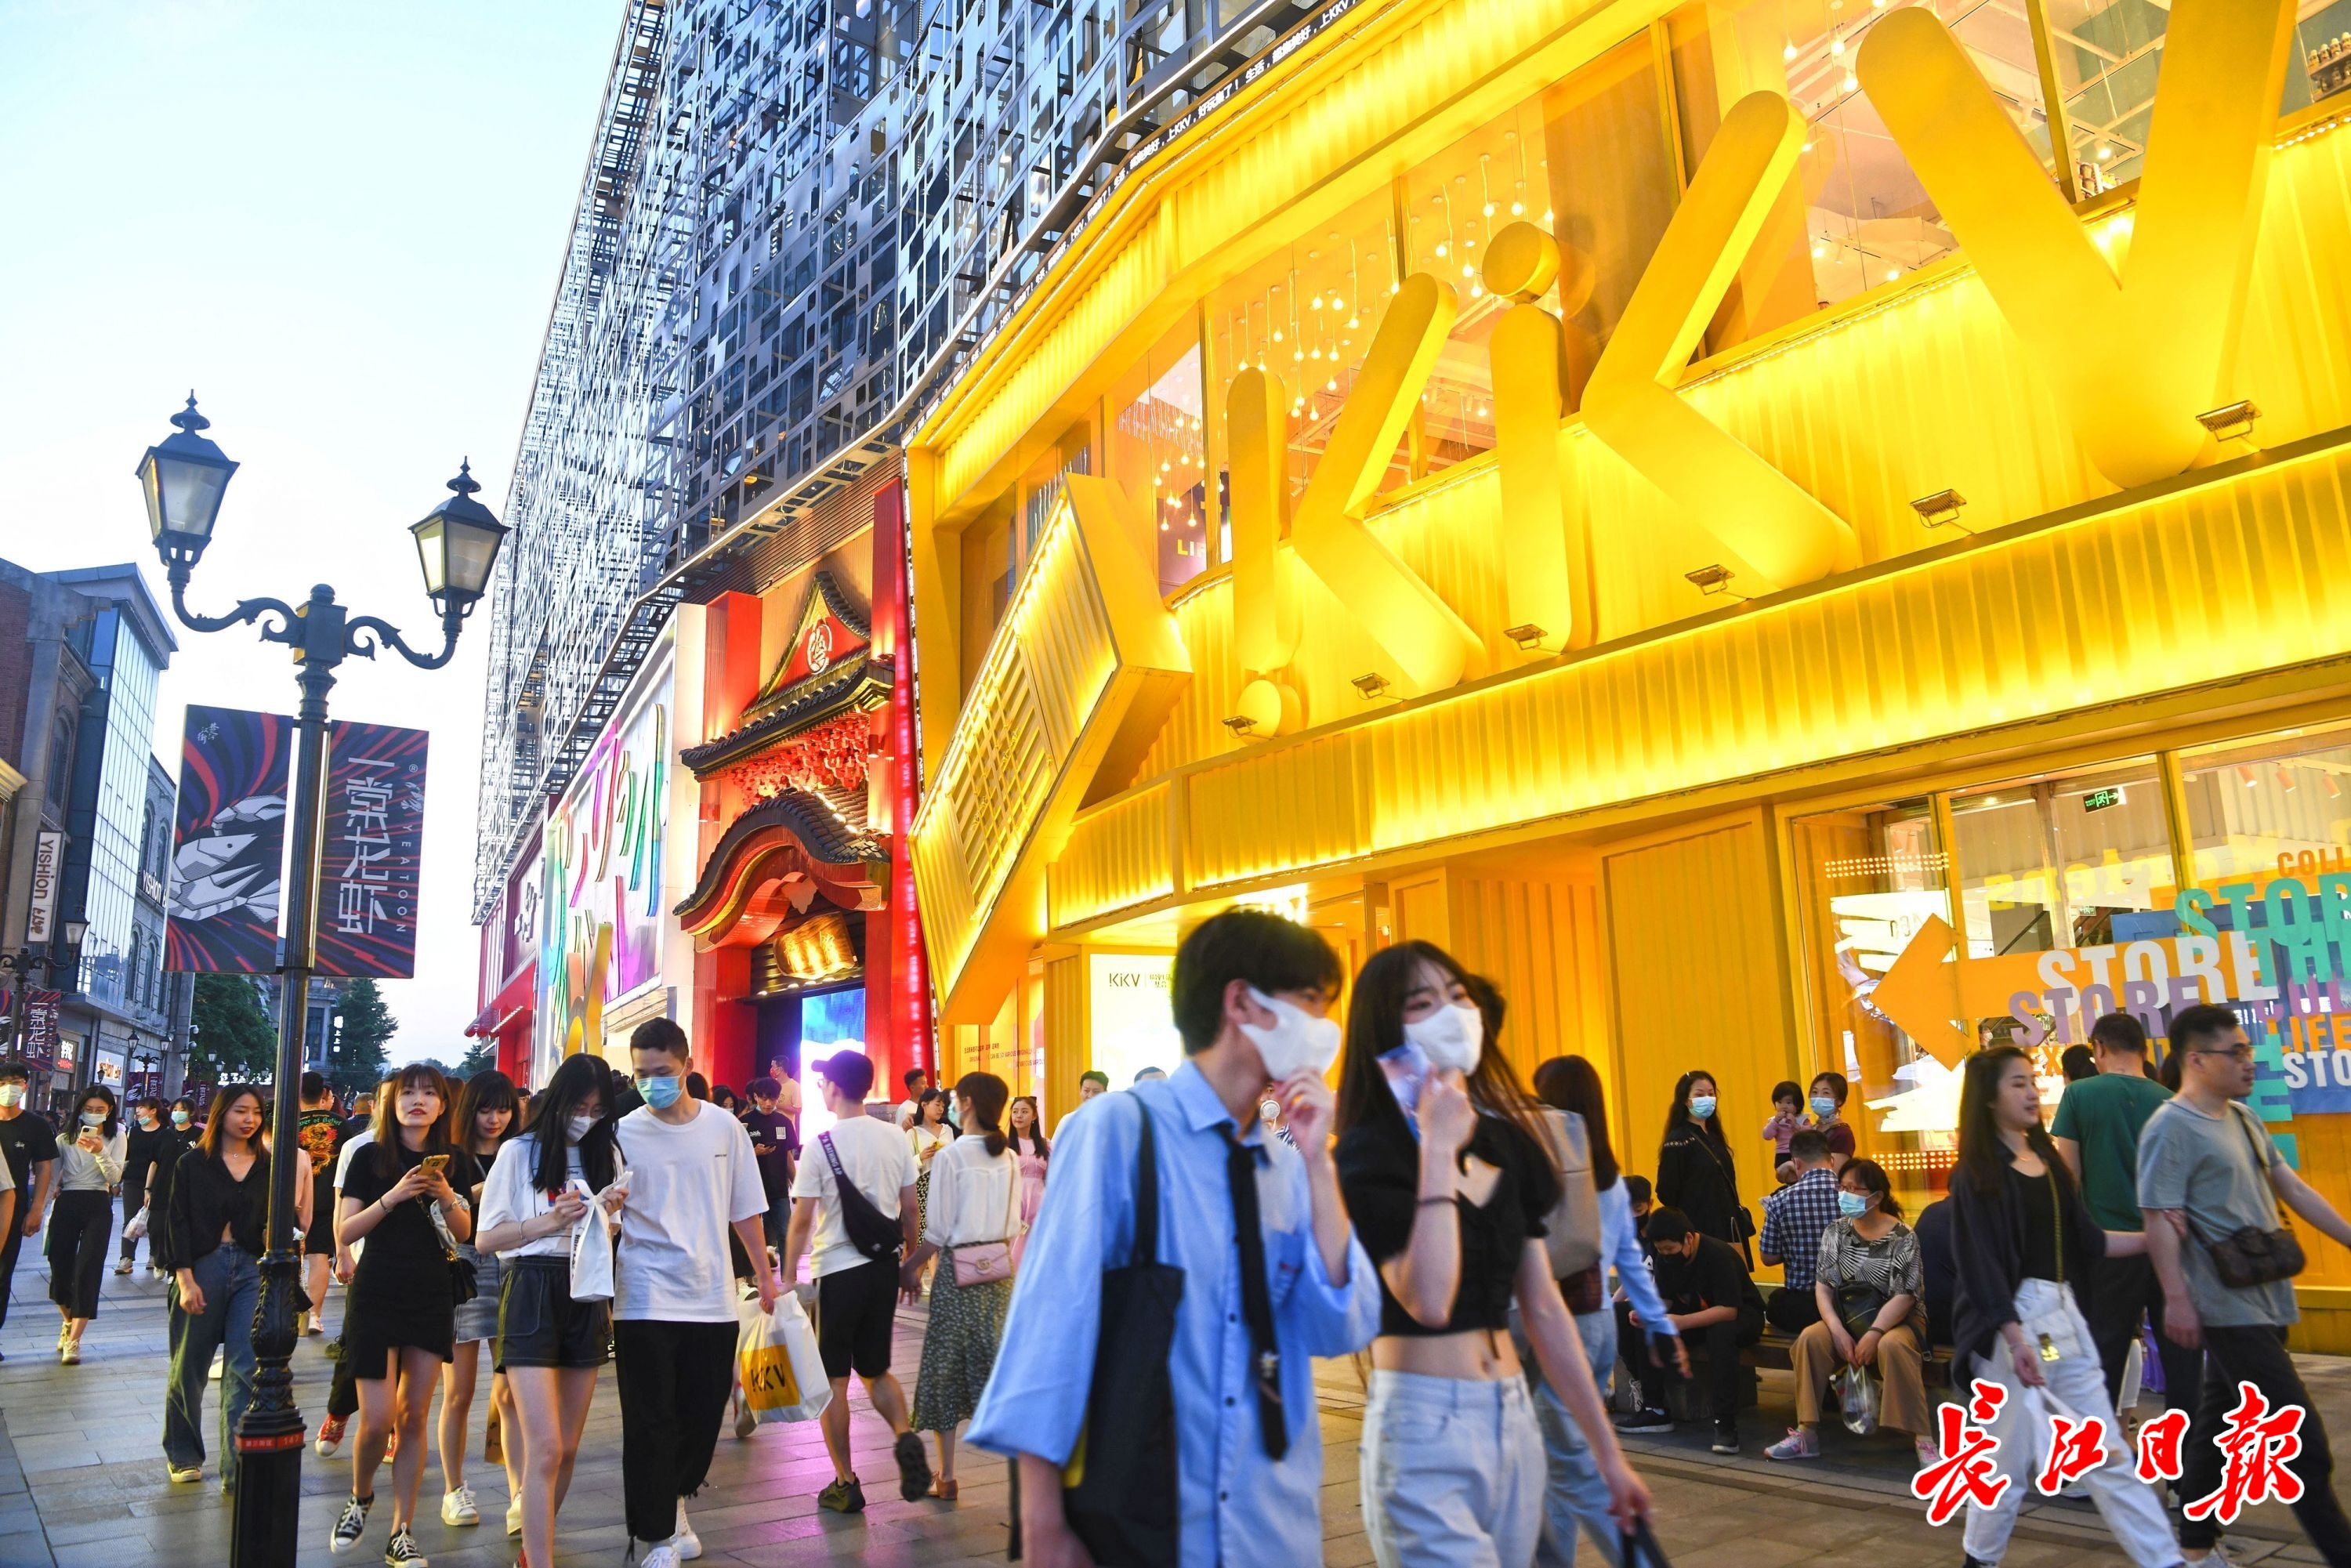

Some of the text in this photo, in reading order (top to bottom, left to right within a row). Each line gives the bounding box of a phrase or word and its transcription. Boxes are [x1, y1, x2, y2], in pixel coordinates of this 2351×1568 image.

[396, 824, 413, 932] YEATOON
[2008, 974, 2201, 1048] STORE
[2038, 930, 2280, 1017] STORE
[750, 1363, 786, 1392] KKV
